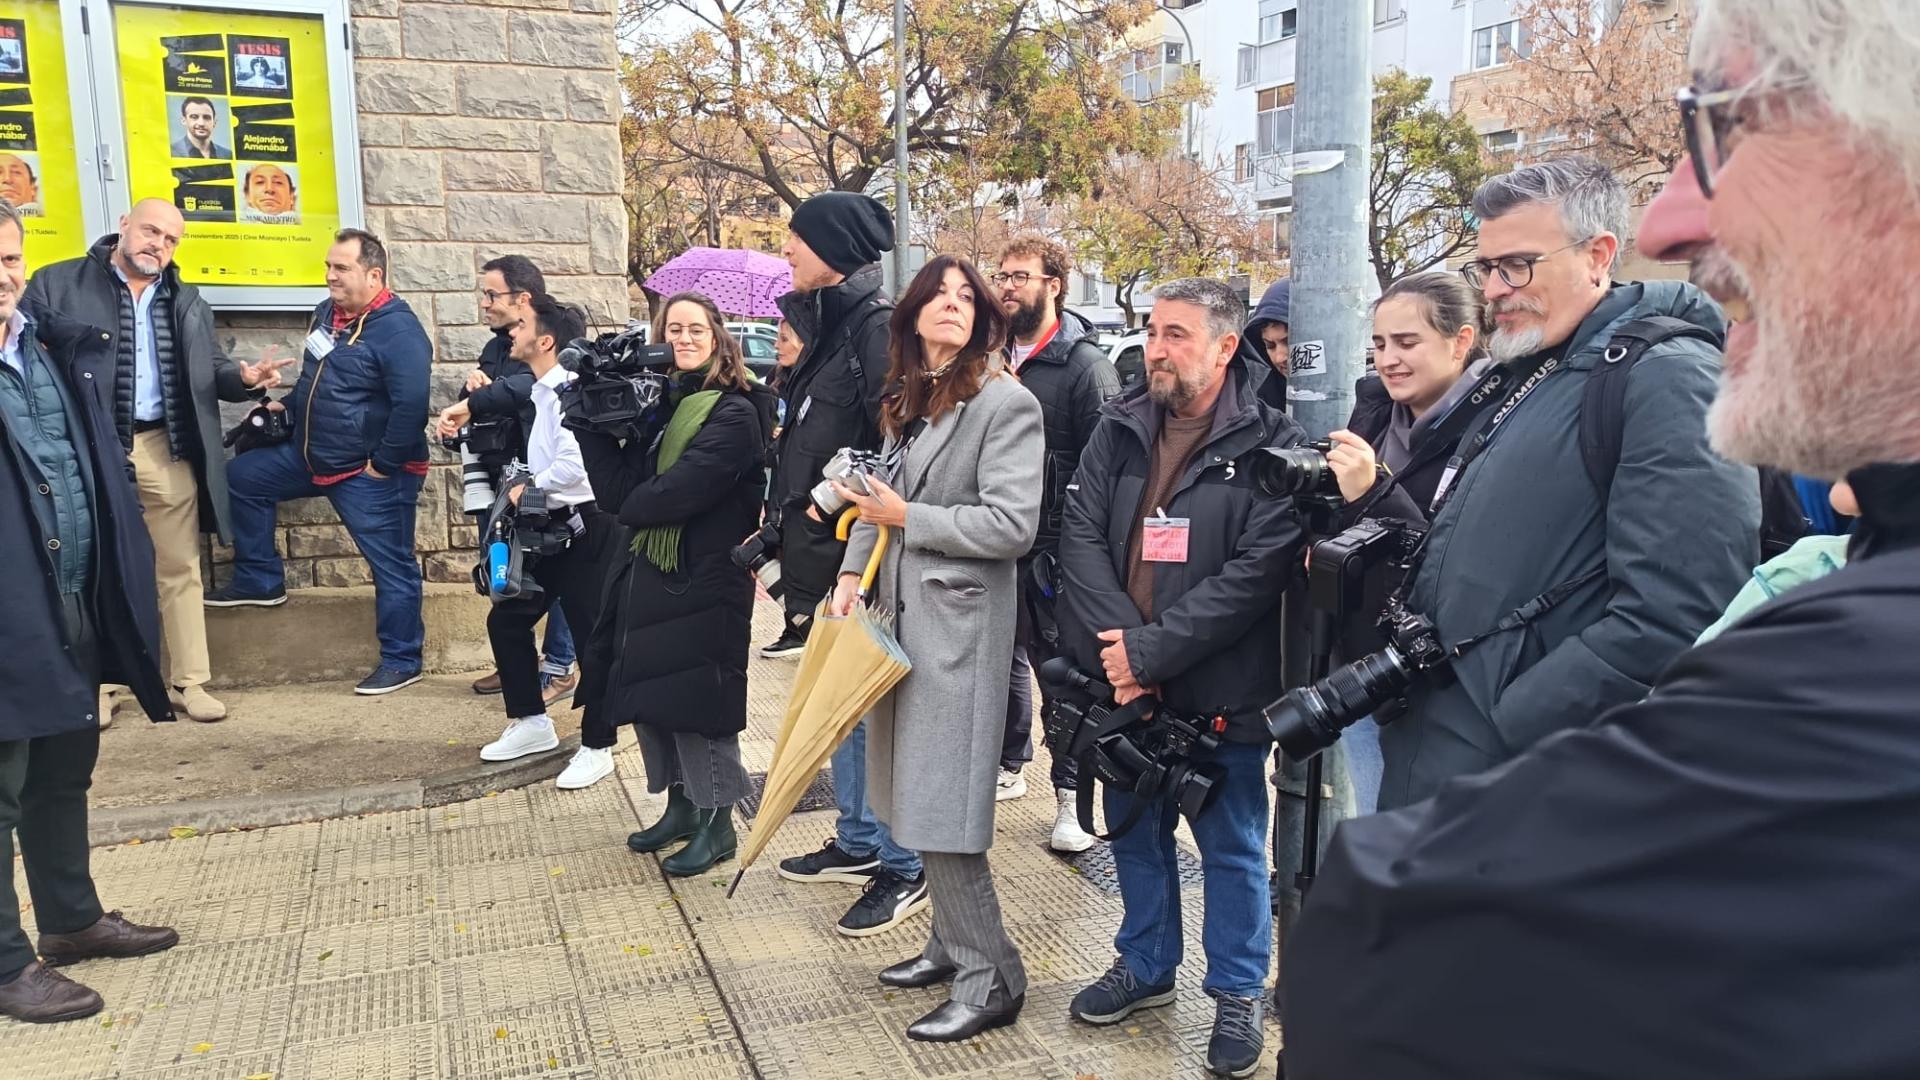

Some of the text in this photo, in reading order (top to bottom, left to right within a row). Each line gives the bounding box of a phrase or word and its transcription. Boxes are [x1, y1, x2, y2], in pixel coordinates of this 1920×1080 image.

[237, 43, 281, 55] TESIS
[243, 135, 285, 144] Alejandro
[244, 143, 288, 152] Amenábar
[1471, 375, 1501, 404] OM-D
[1492, 358, 1558, 424] OLYMPUS
[1098, 764, 1118, 781] SONY
